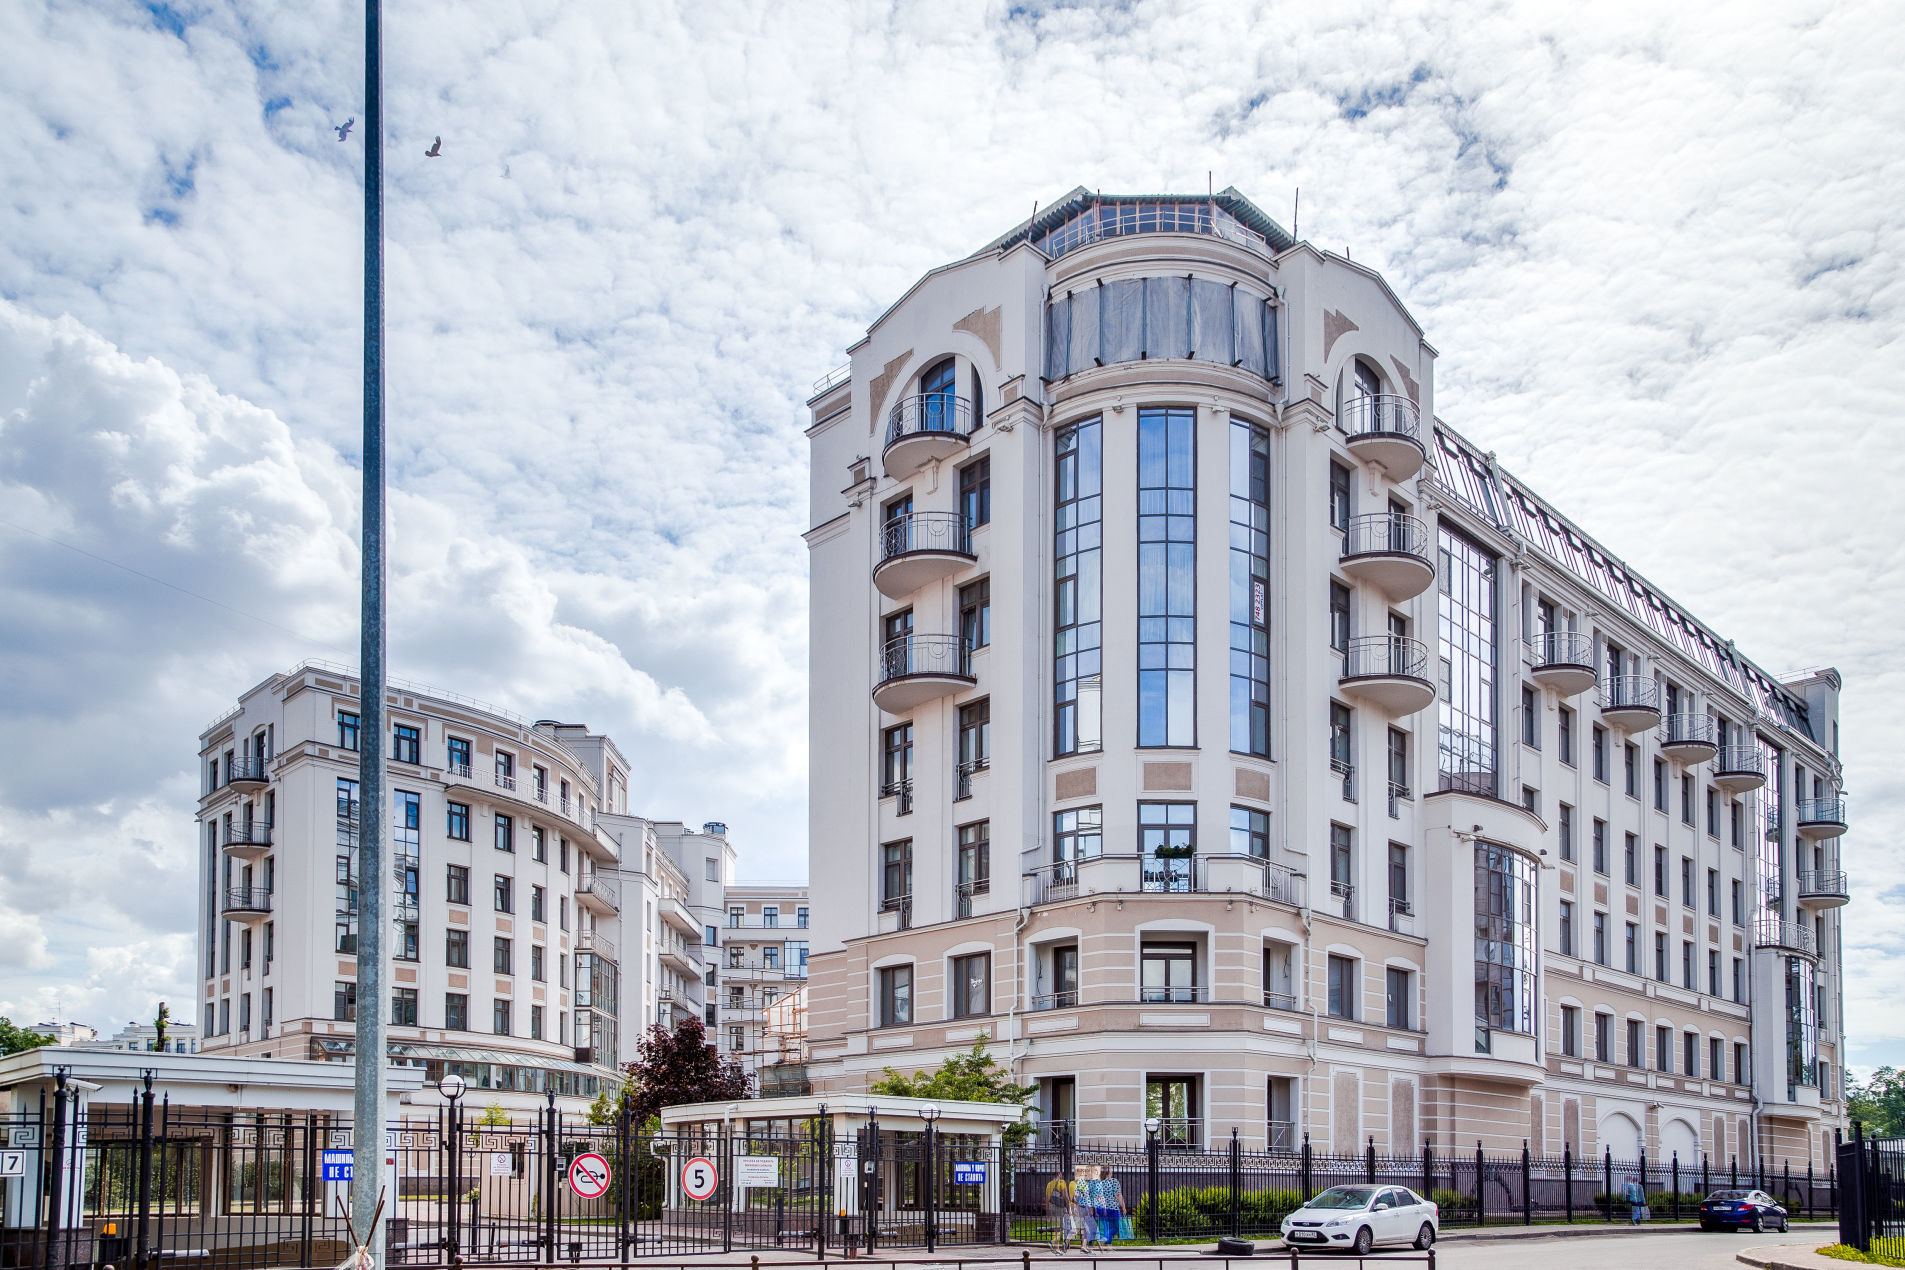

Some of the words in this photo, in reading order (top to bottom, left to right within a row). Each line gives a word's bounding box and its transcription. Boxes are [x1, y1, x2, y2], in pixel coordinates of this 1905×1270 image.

[8, 1156, 18, 1170] 7
[329, 1166, 339, 1178] НЕ
[694, 1170, 704, 1188] 5
